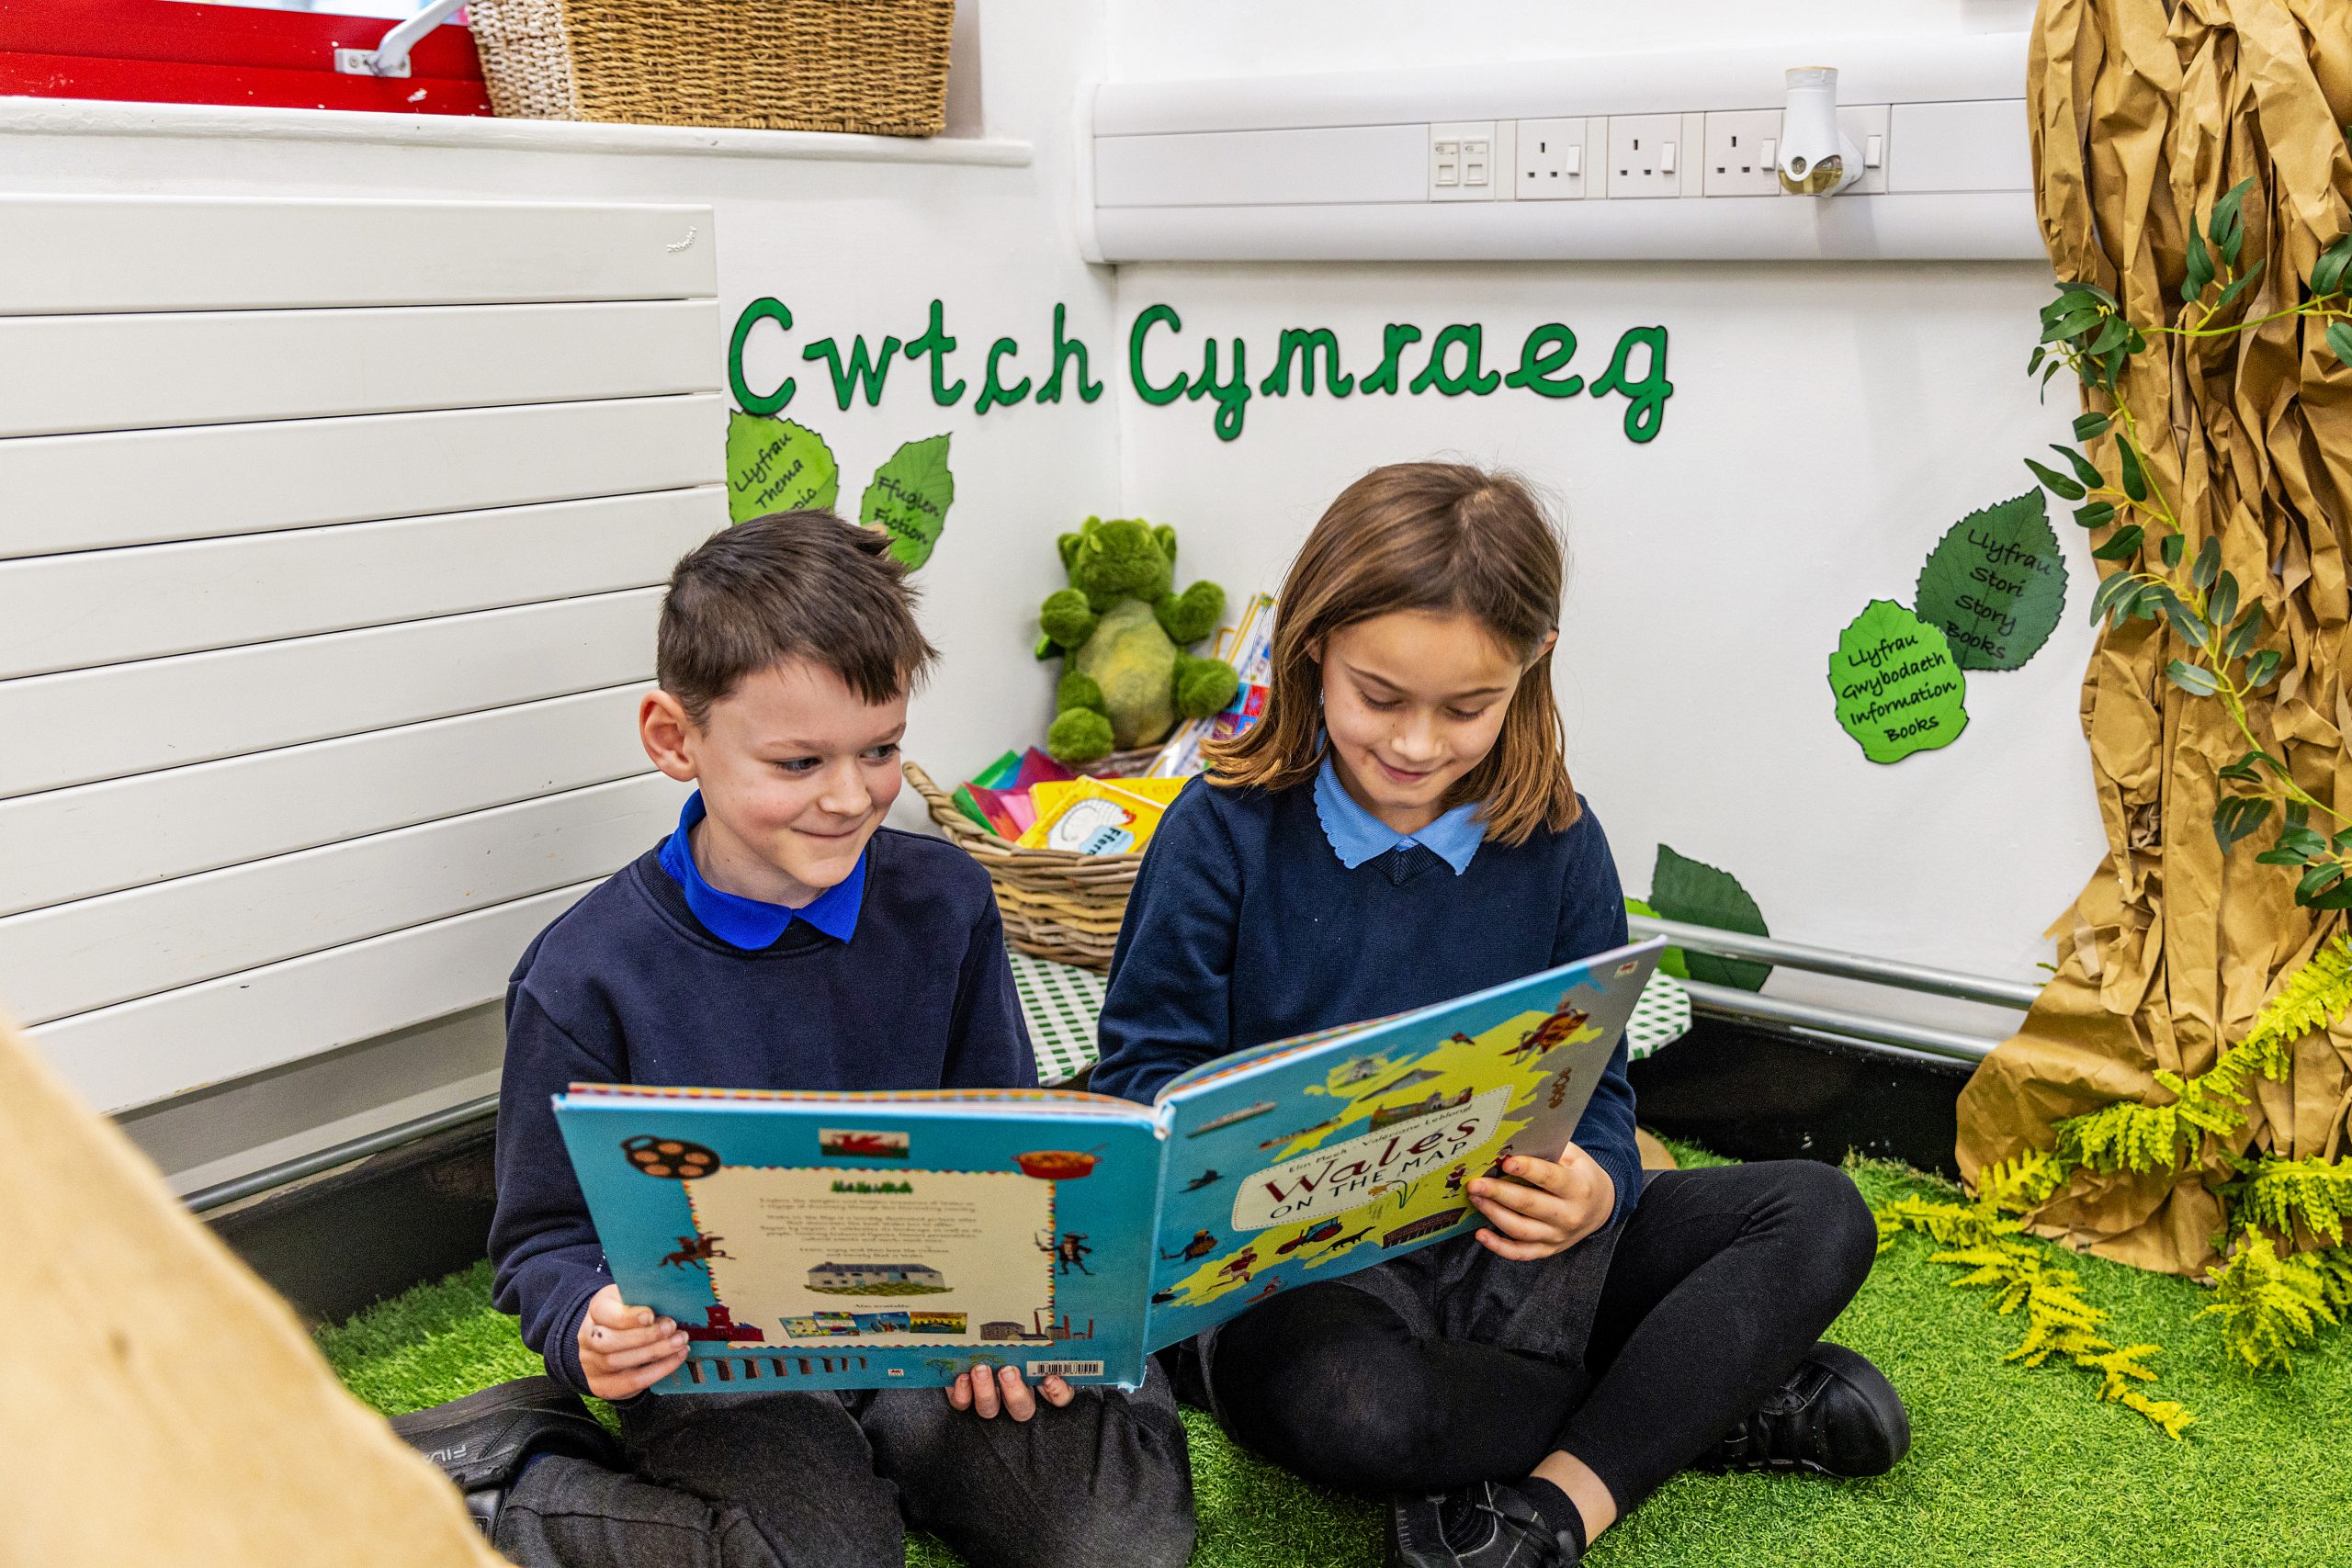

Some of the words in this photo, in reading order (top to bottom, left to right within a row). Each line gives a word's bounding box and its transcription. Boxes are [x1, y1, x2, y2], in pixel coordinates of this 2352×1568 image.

[729, 297, 1103, 417] Cwtch
[1129, 304, 1674, 444] Cymraeg
[734, 433, 793, 492] Llyfrau
[754, 458, 804, 509] Thema
[877, 476, 940, 516] Ffuglen
[874, 506, 928, 545] Fiction
[1968, 528, 2051, 575] Llyfrau
[1970, 567, 2026, 597] Stori
[1955, 594, 2017, 637] Story
[1848, 634, 1918, 668] Llyfrau
[1946, 620, 2006, 660] Books
[1842, 652, 1946, 699] Gwybodaeth
[1849, 682, 1957, 726] Information
[1883, 716, 1939, 742] Books
[1260, 1117, 1480, 1202] Wales
[1270, 1195, 1313, 1219] ON
[1329, 1168, 1387, 1197] THE
[1401, 1142, 1467, 1174] MAP
